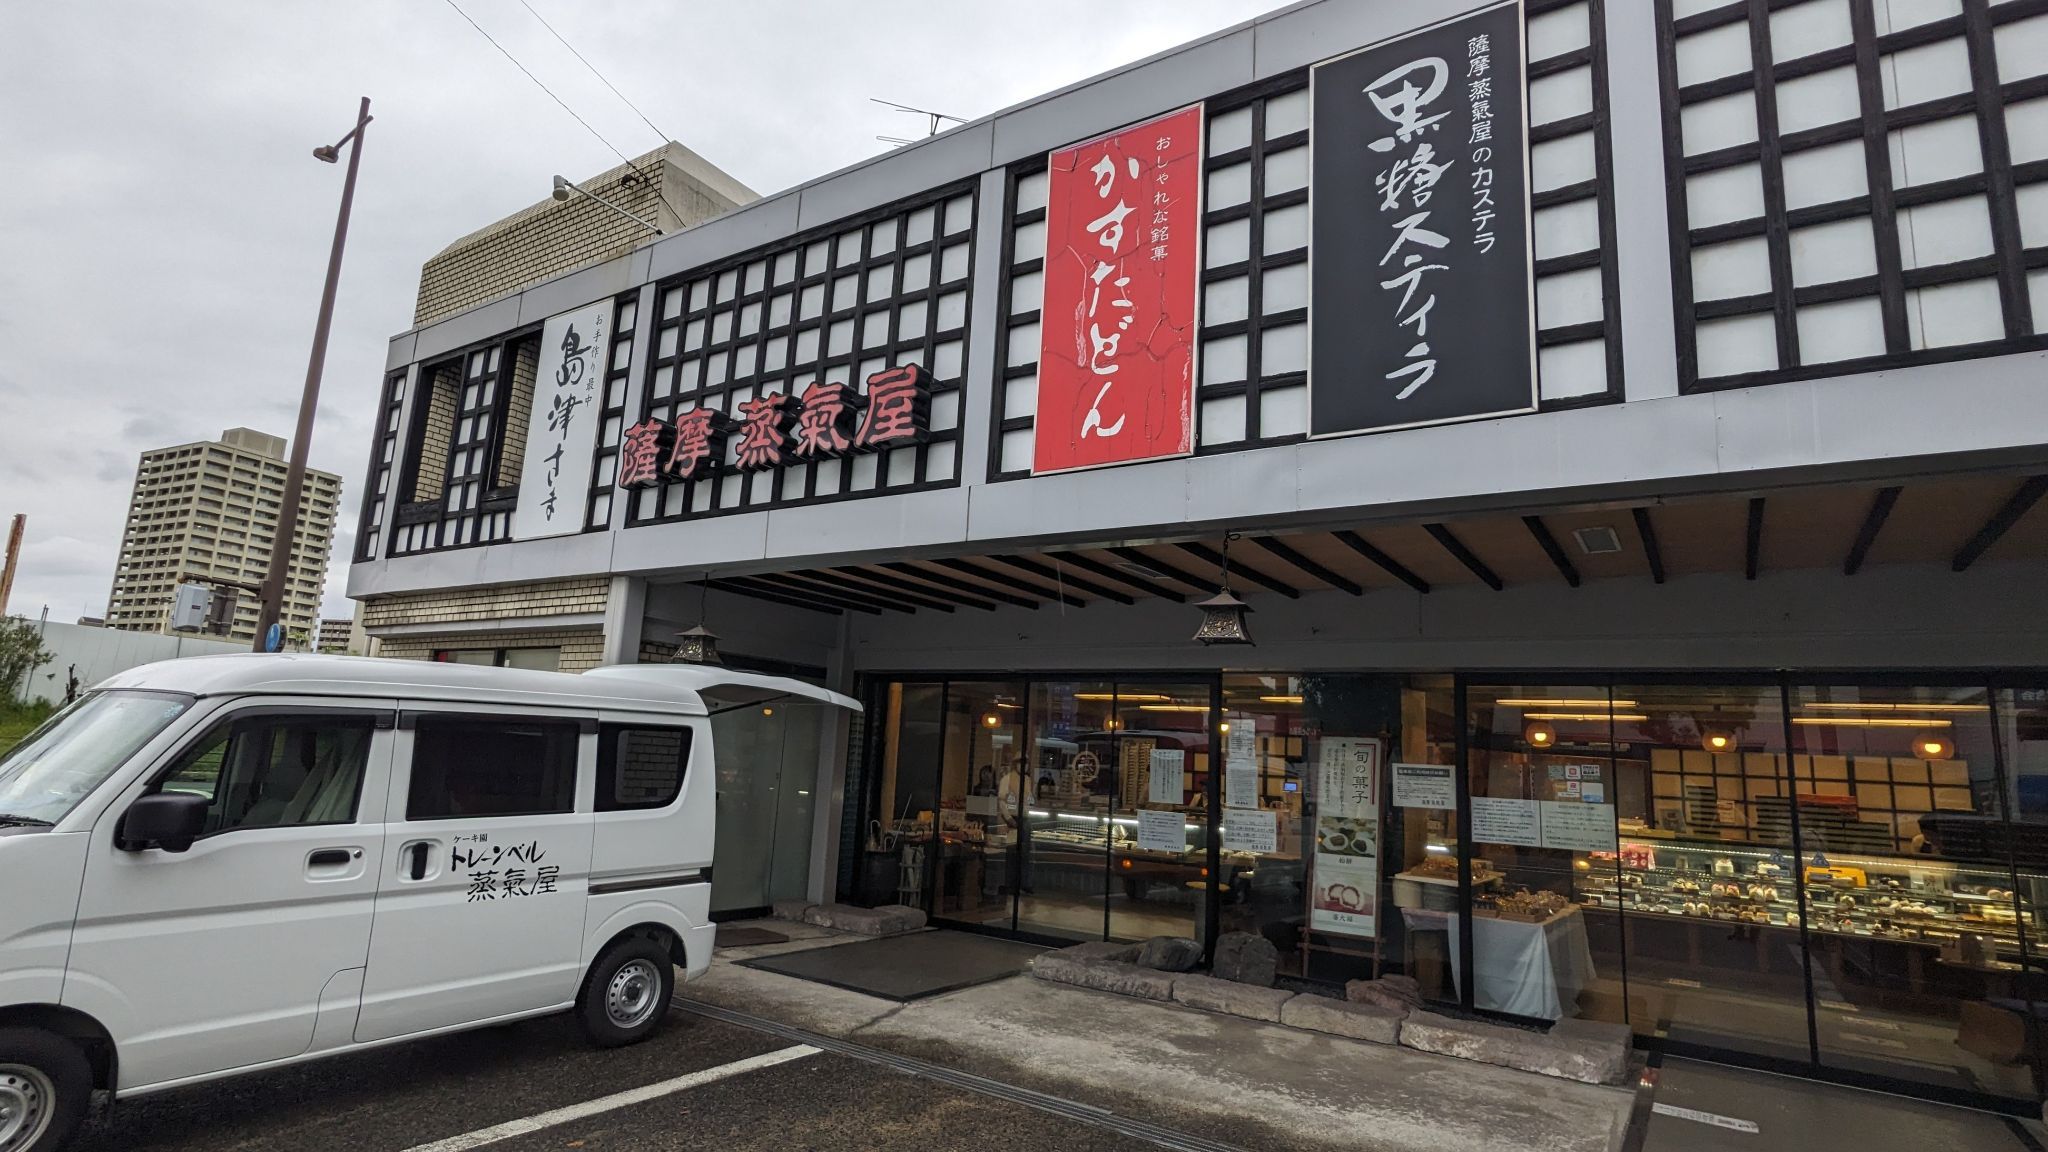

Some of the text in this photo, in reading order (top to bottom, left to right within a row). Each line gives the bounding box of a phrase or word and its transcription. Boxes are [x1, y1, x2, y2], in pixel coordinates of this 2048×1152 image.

[1150, 136, 1171, 261] おしゃれな銘菓
[1467, 34, 1496, 254] 薩摩蒸氣屋のカステラ
[1081, 154, 1140, 438] かすたどん
[540, 323, 592, 521] 島津さま
[585, 313, 603, 407] お手作り最中
[619, 363, 922, 490] 薩摩蒸氣屋
[1351, 750, 1369, 804] 旬の菓子
[467, 865, 560, 903] 蒸氣屋
